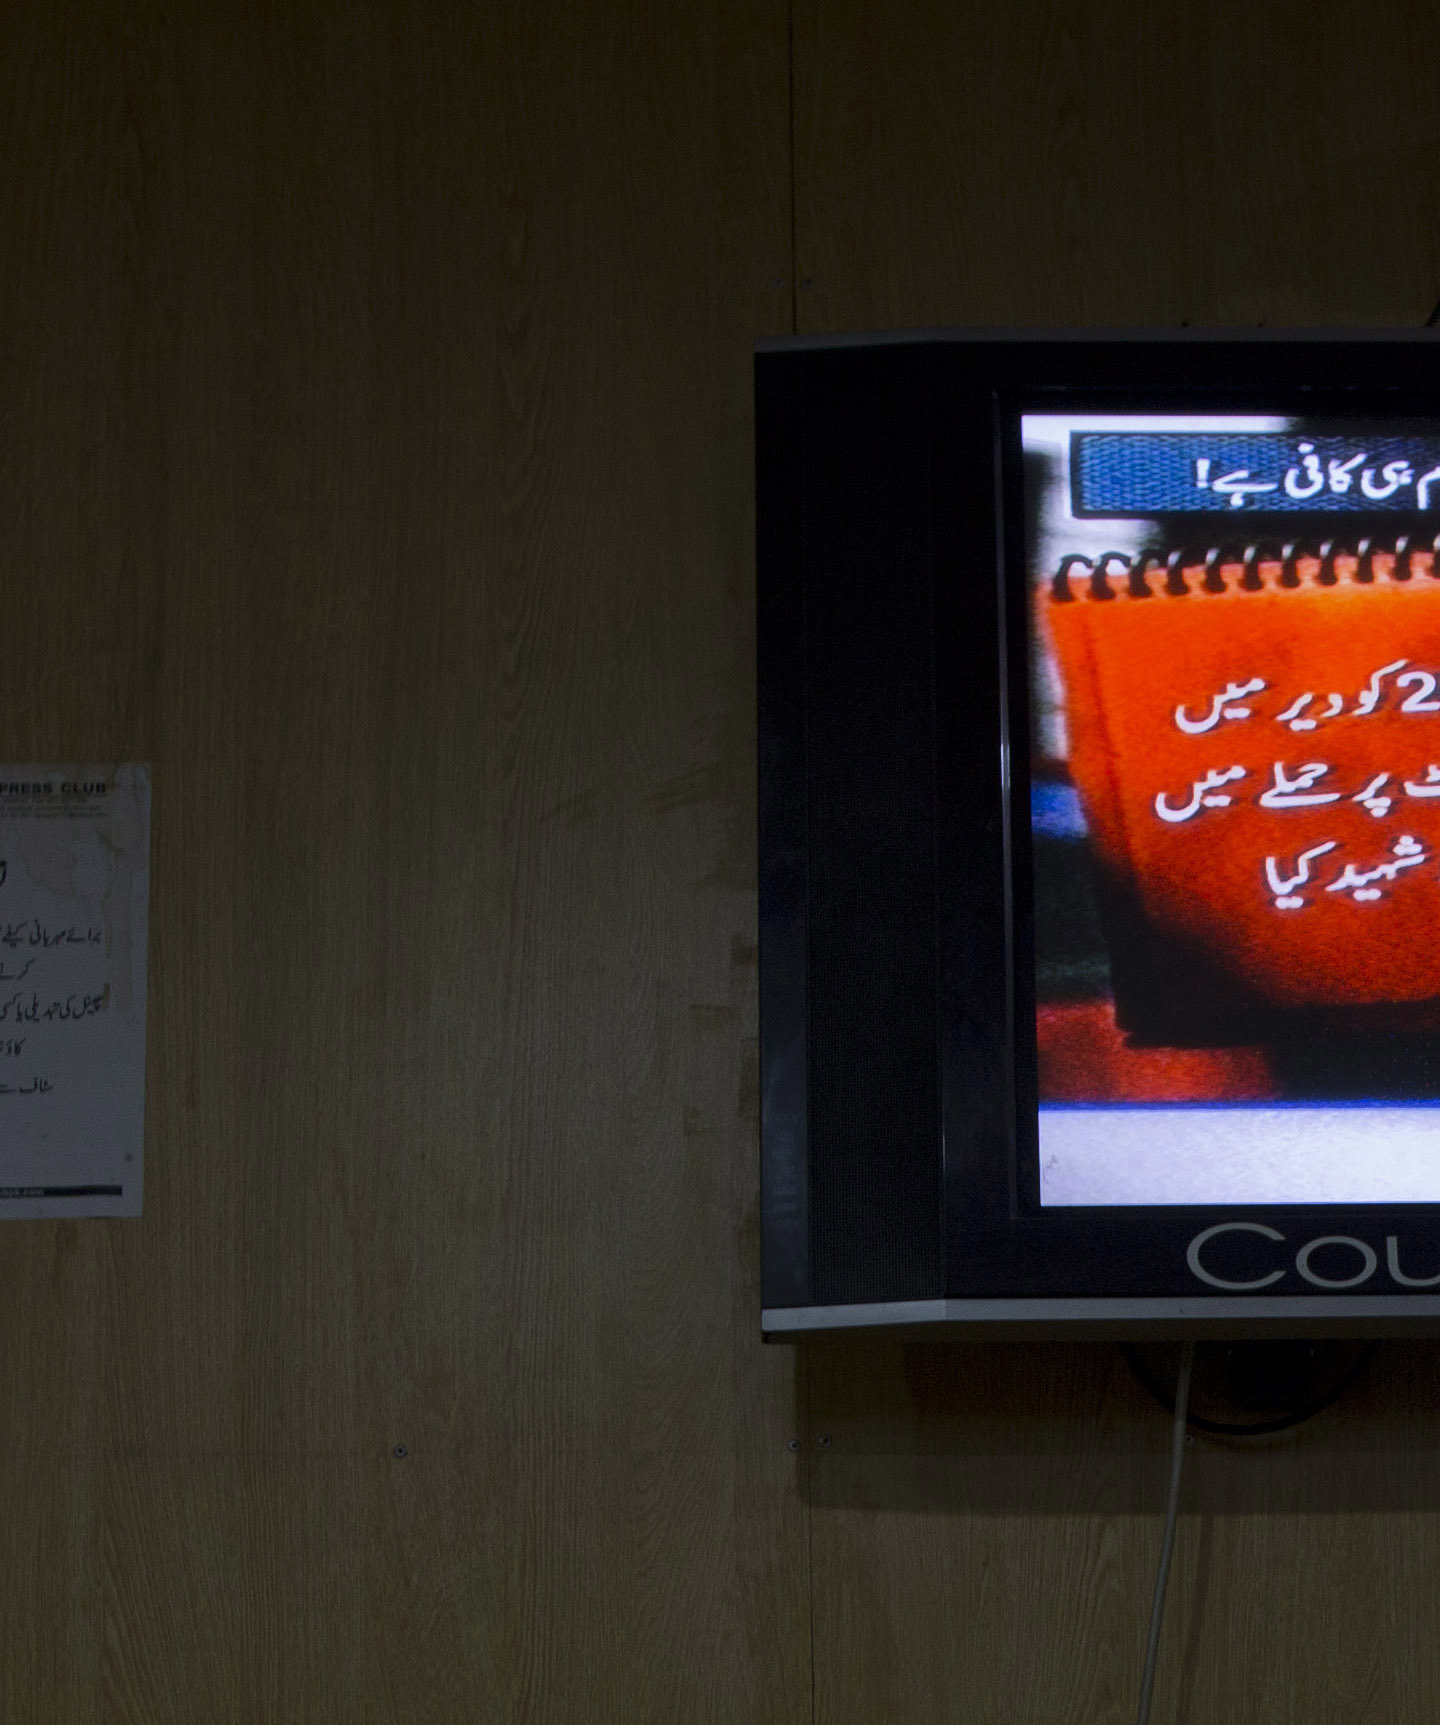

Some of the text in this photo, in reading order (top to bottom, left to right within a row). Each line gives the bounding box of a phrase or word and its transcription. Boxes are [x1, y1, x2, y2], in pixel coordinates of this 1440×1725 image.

[1284, 443, 1367, 499] کافی
[1361, 459, 1413, 498] ہی
[1174, 677, 1265, 734] میں
[1276, 692, 1343, 730] دیر
[1354, 658, 1409, 717] کو
[61, 781, 107, 795] CLUB
[1155, 764, 1246, 823] میں
[1260, 760, 1340, 808] حملے
[1352, 771, 1391, 817] پر
[1264, 840, 1337, 909] کیا
[1326, 835, 1425, 902] شہید
